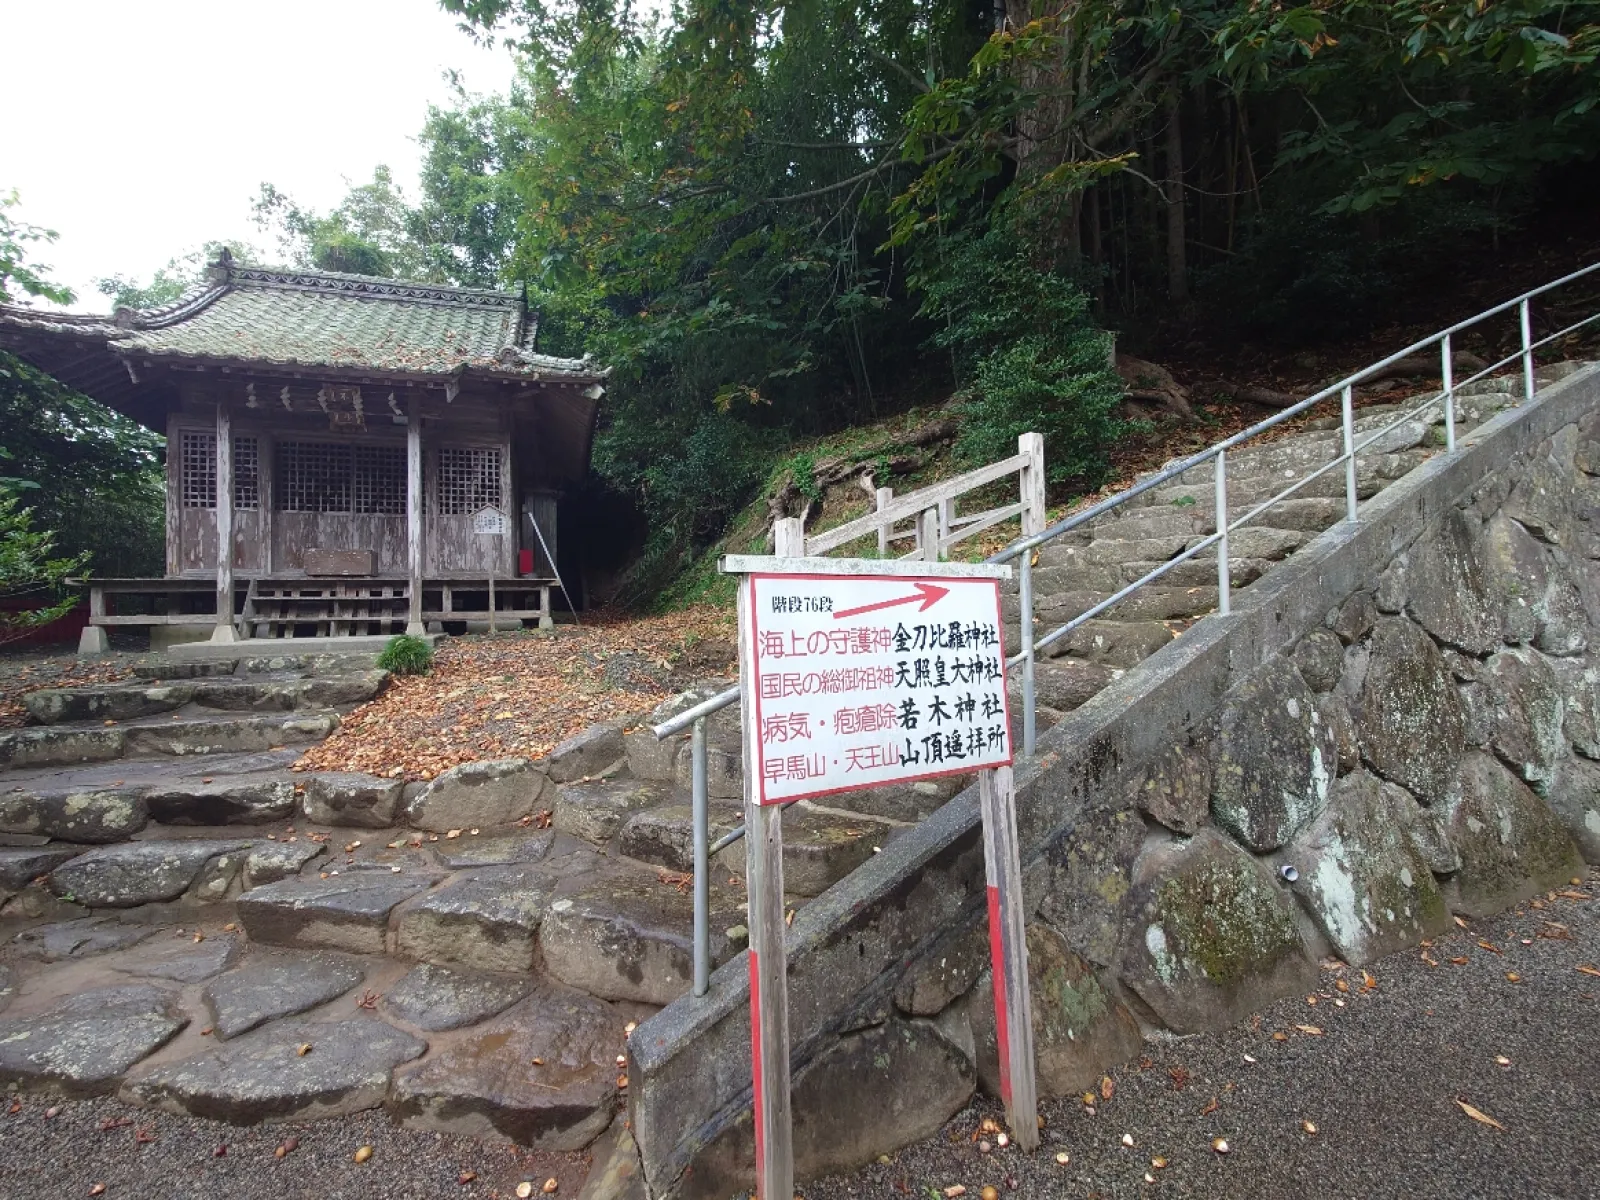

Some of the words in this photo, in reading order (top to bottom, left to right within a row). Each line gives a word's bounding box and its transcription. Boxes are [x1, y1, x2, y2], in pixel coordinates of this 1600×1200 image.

[772, 596, 833, 613] 階段76段
[759, 627, 892, 659] 海上の守護神
[892, 620, 999, 653] 金刀比羅神社
[760, 665, 894, 699] 国民の総御祖神
[895, 653, 1003, 689] 天照皇大神社
[896, 691, 1004, 730] 若木神社
[764, 742, 900, 784] 早馬山・天王山
